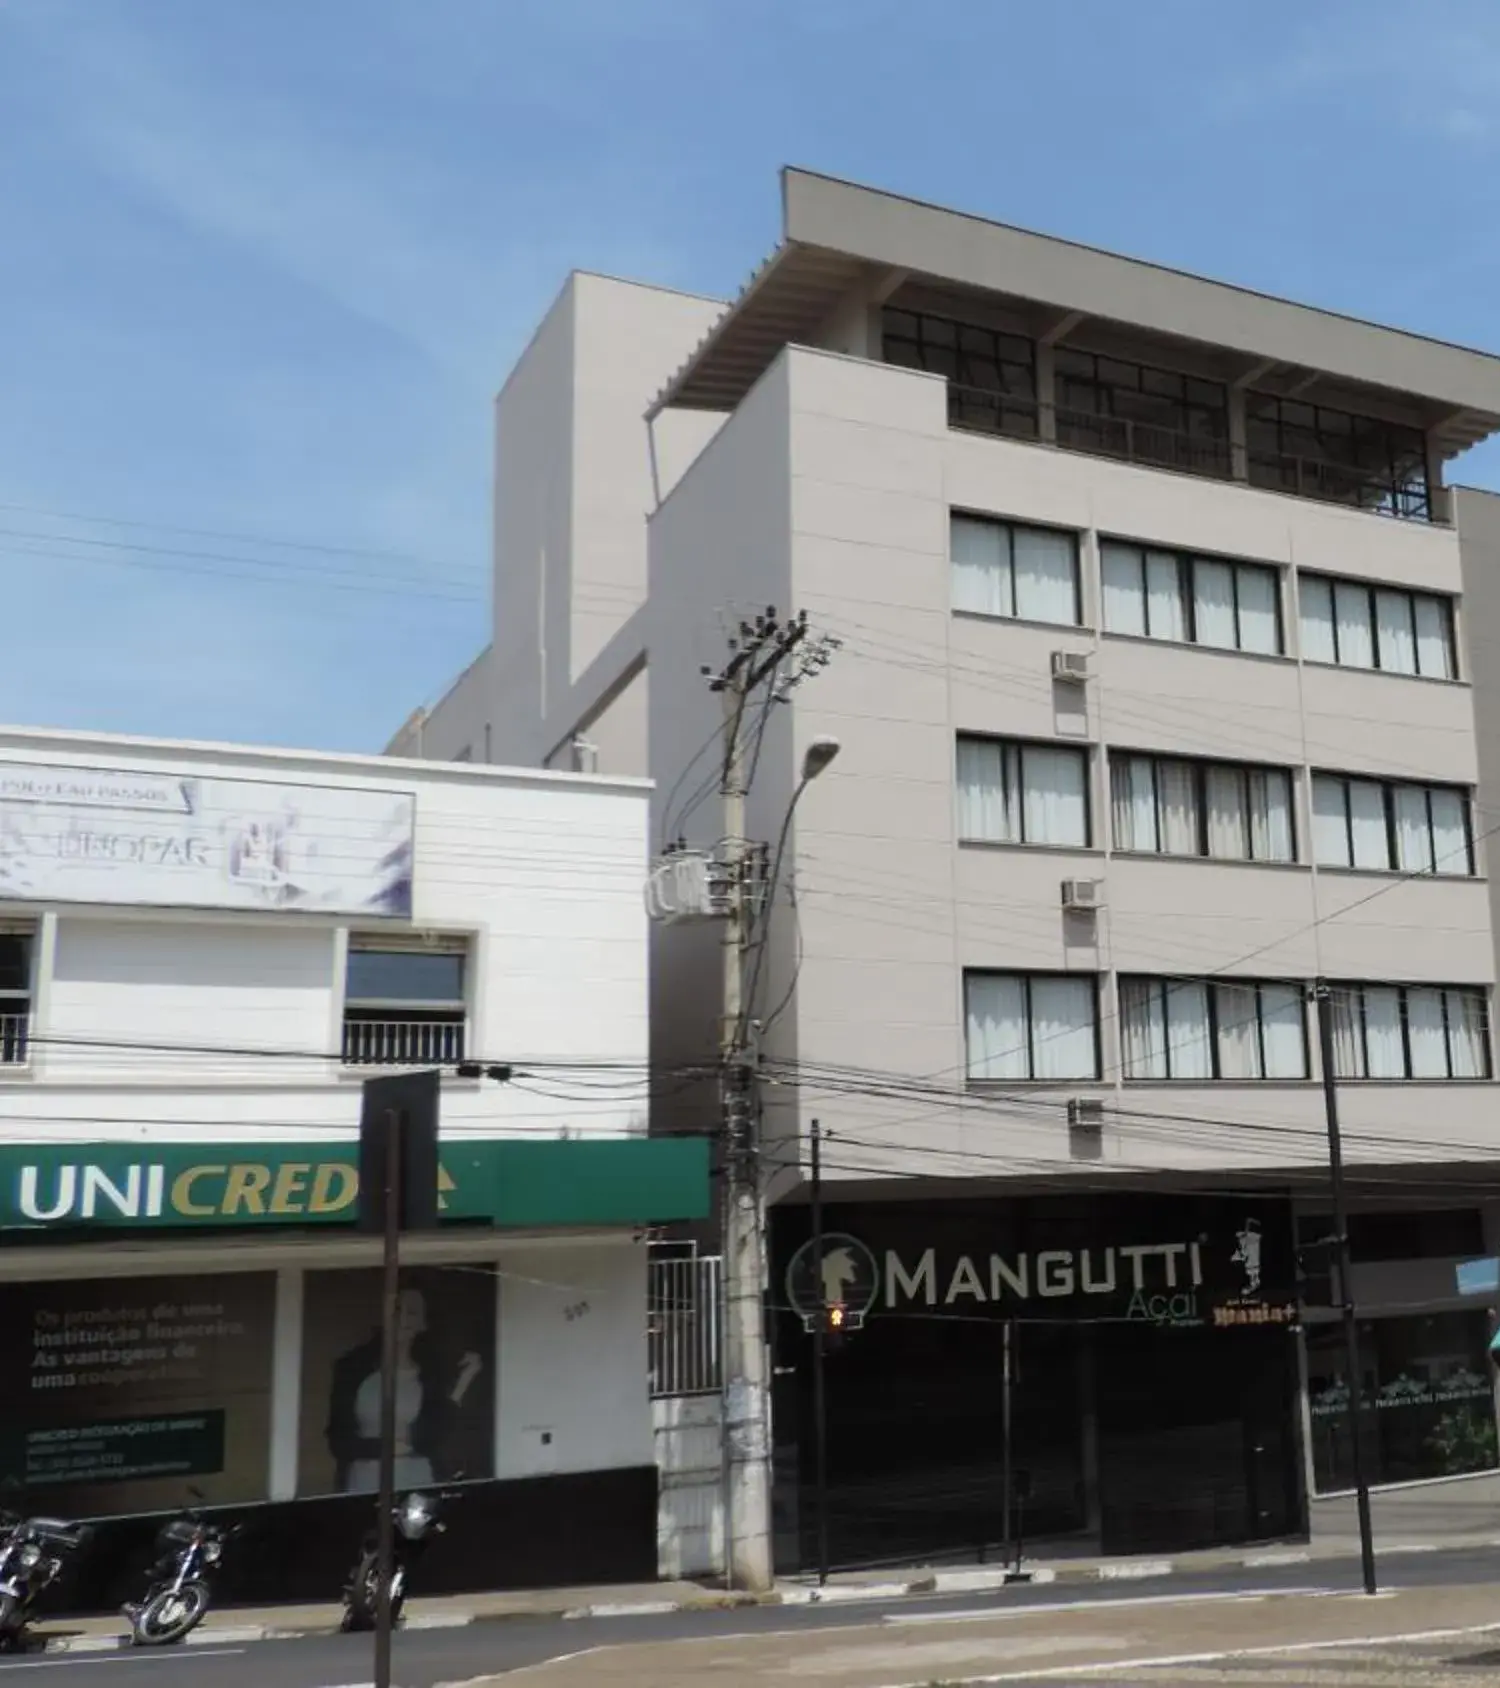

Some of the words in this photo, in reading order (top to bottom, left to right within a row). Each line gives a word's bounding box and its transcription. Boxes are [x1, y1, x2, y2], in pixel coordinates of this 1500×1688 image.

[18, 1163, 360, 1220] UNICRED
[885, 1242, 1201, 1308] MANGUTTI
[152, 1303, 177, 1320] de
[31, 1351, 58, 1368] As
[63, 1346, 168, 1367] vantagens
[172, 1341, 198, 1358] de
[31, 1373, 77, 1389] uma
